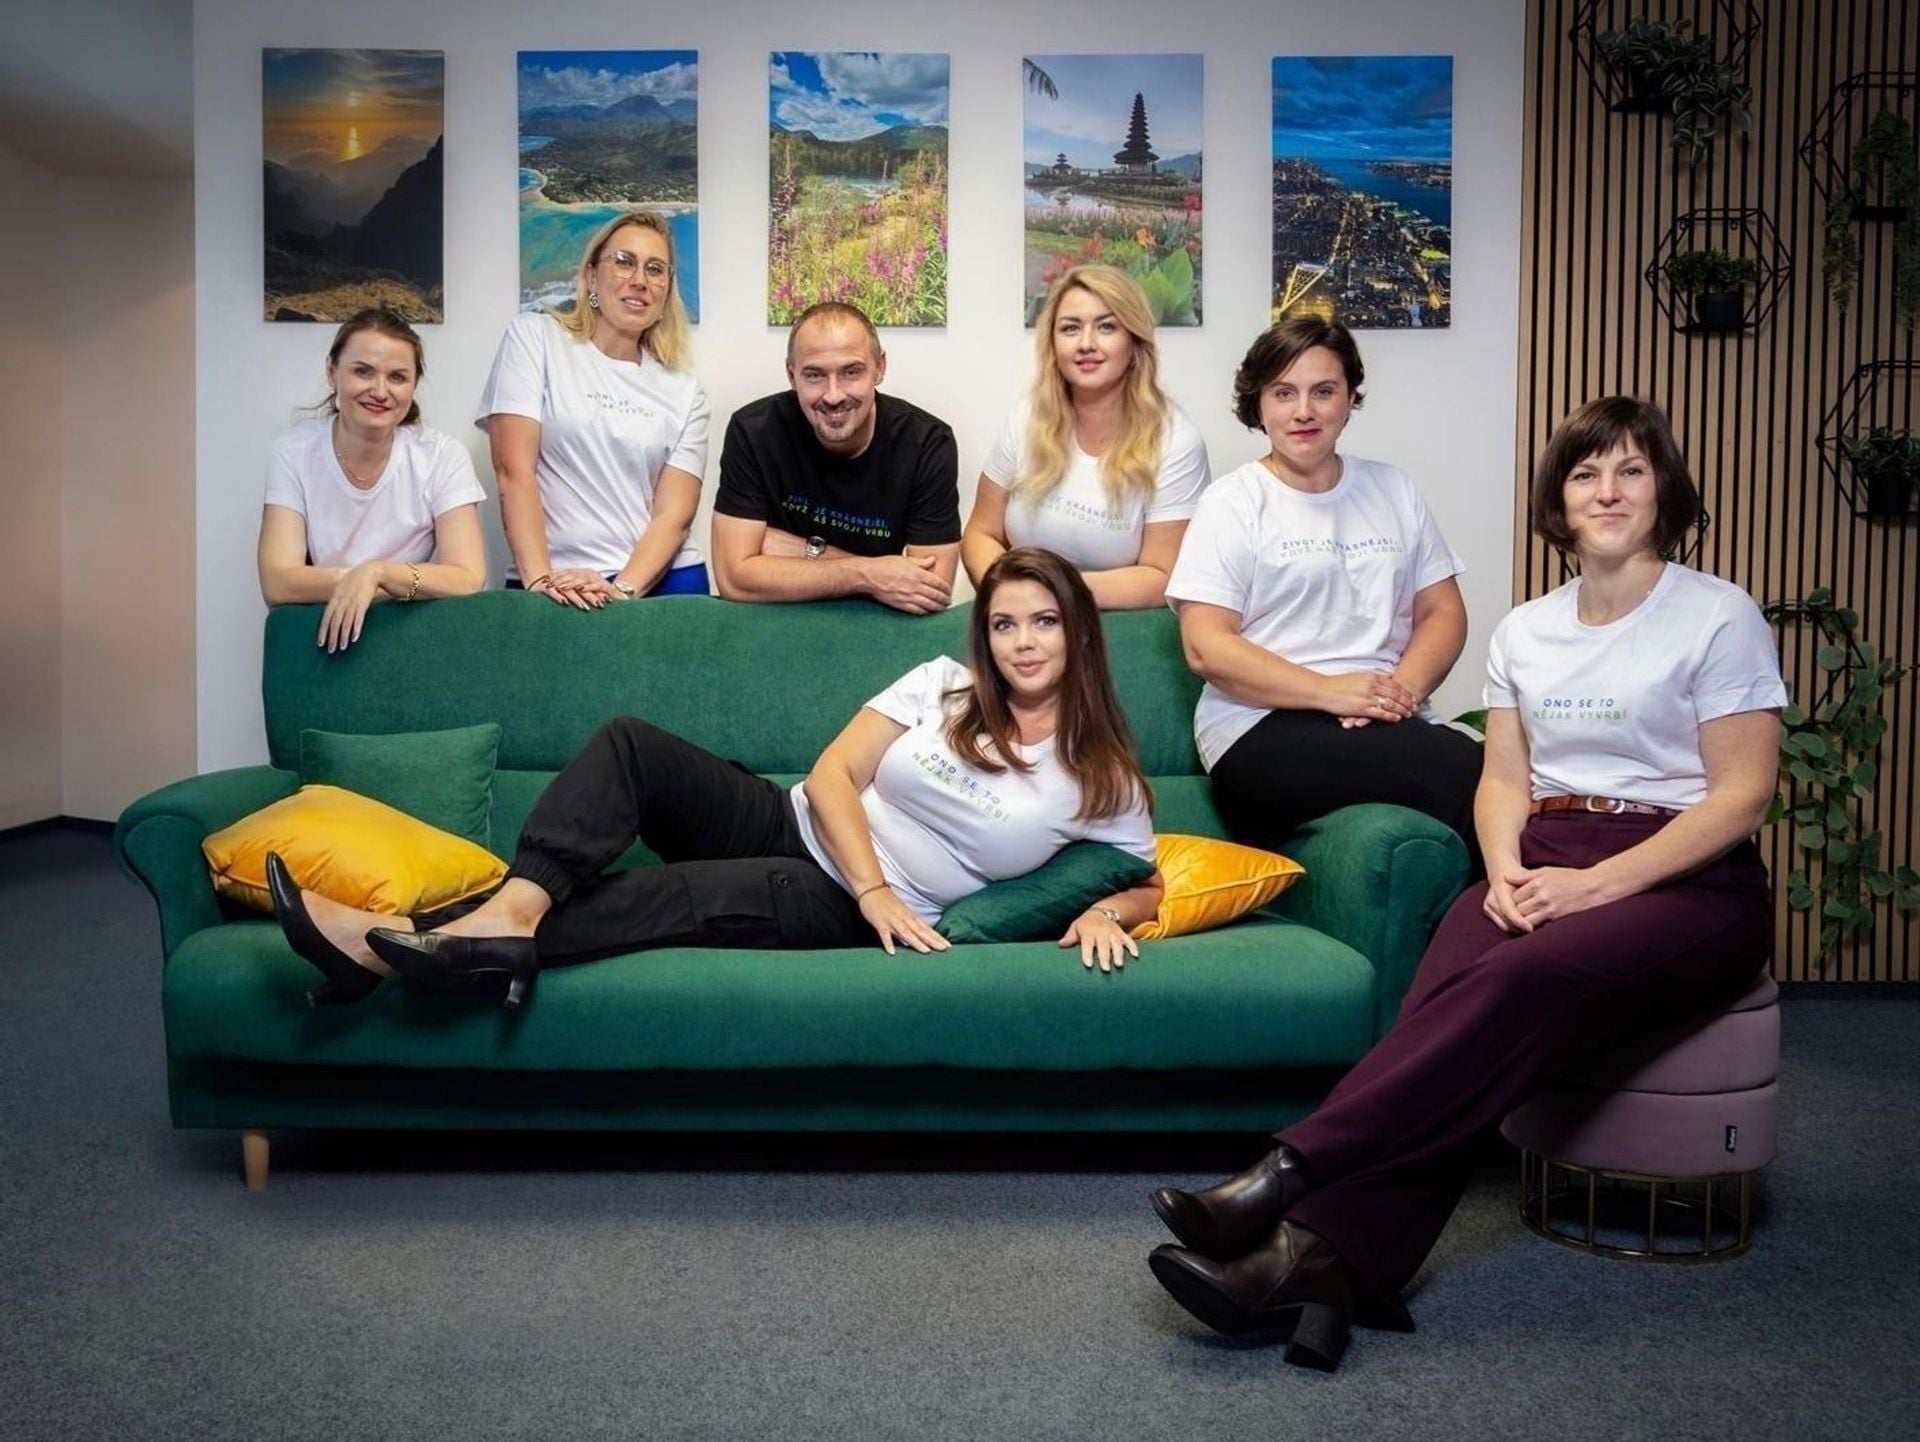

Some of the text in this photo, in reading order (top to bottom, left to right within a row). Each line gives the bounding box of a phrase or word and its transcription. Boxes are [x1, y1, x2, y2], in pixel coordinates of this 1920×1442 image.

[865, 527, 891, 538] VRBU
[1543, 698, 1614, 708] ONO SE TO
[930, 753, 1000, 804] ONO SE TO
